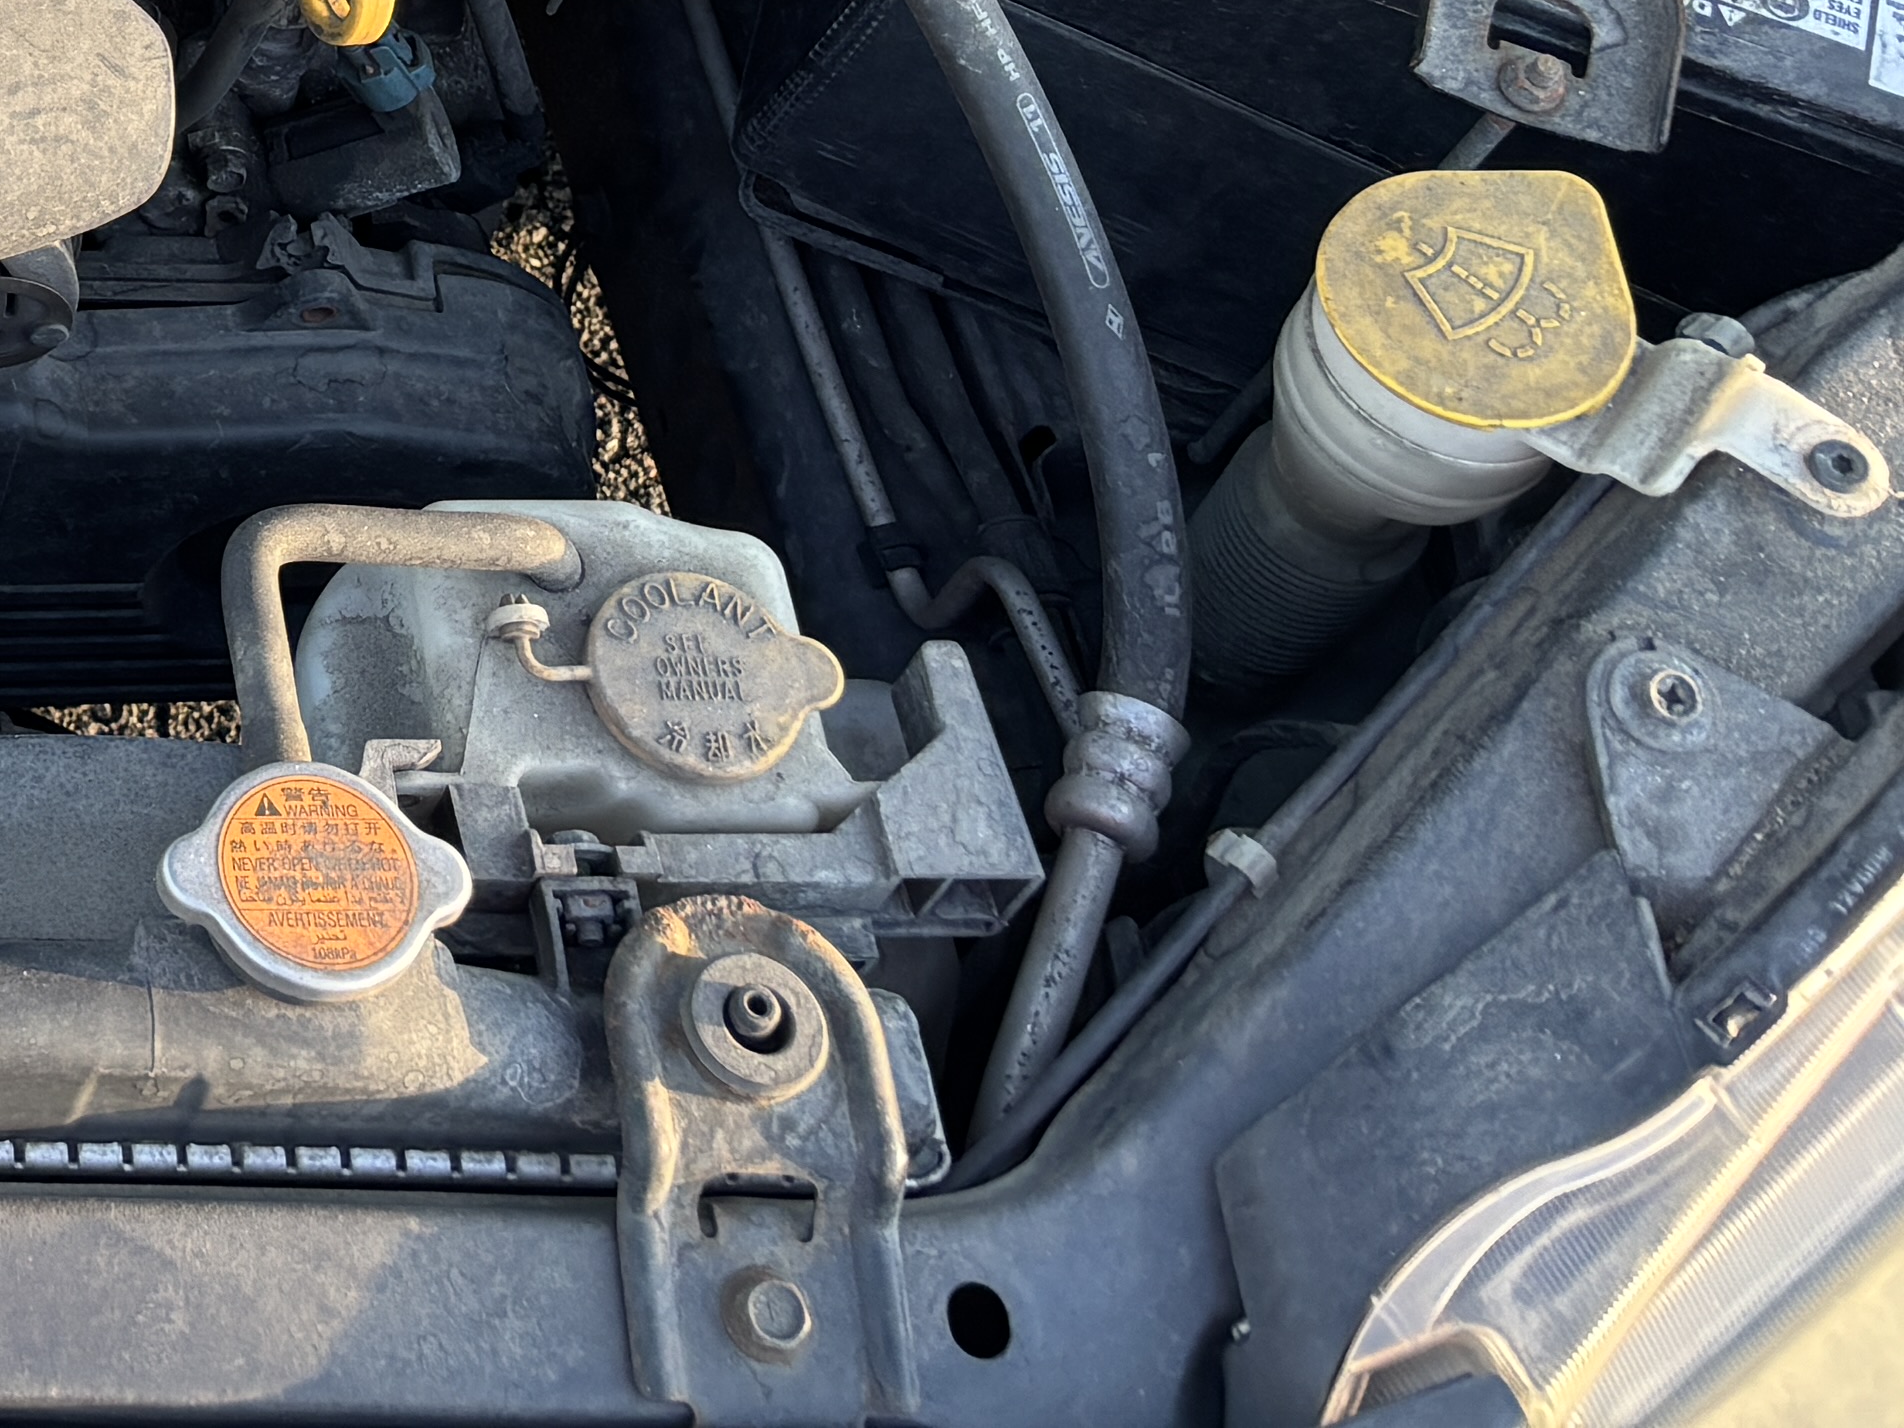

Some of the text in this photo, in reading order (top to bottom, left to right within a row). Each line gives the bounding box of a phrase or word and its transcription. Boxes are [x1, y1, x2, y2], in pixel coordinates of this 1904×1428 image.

[1810, 7, 1861, 34] SHIELD
[993, 45, 1021, 82] HP
[1021, 103, 1106, 275] AVESIS 11
[605, 575, 779, 643] COOLANT
[659, 712, 772, 763] 冷却水
[280, 787, 332, 805] 警告
[283, 804, 358, 818] WARNING
[232, 857, 276, 872] NEVER
[268, 911, 388, 929] AVERTISSEMENT
